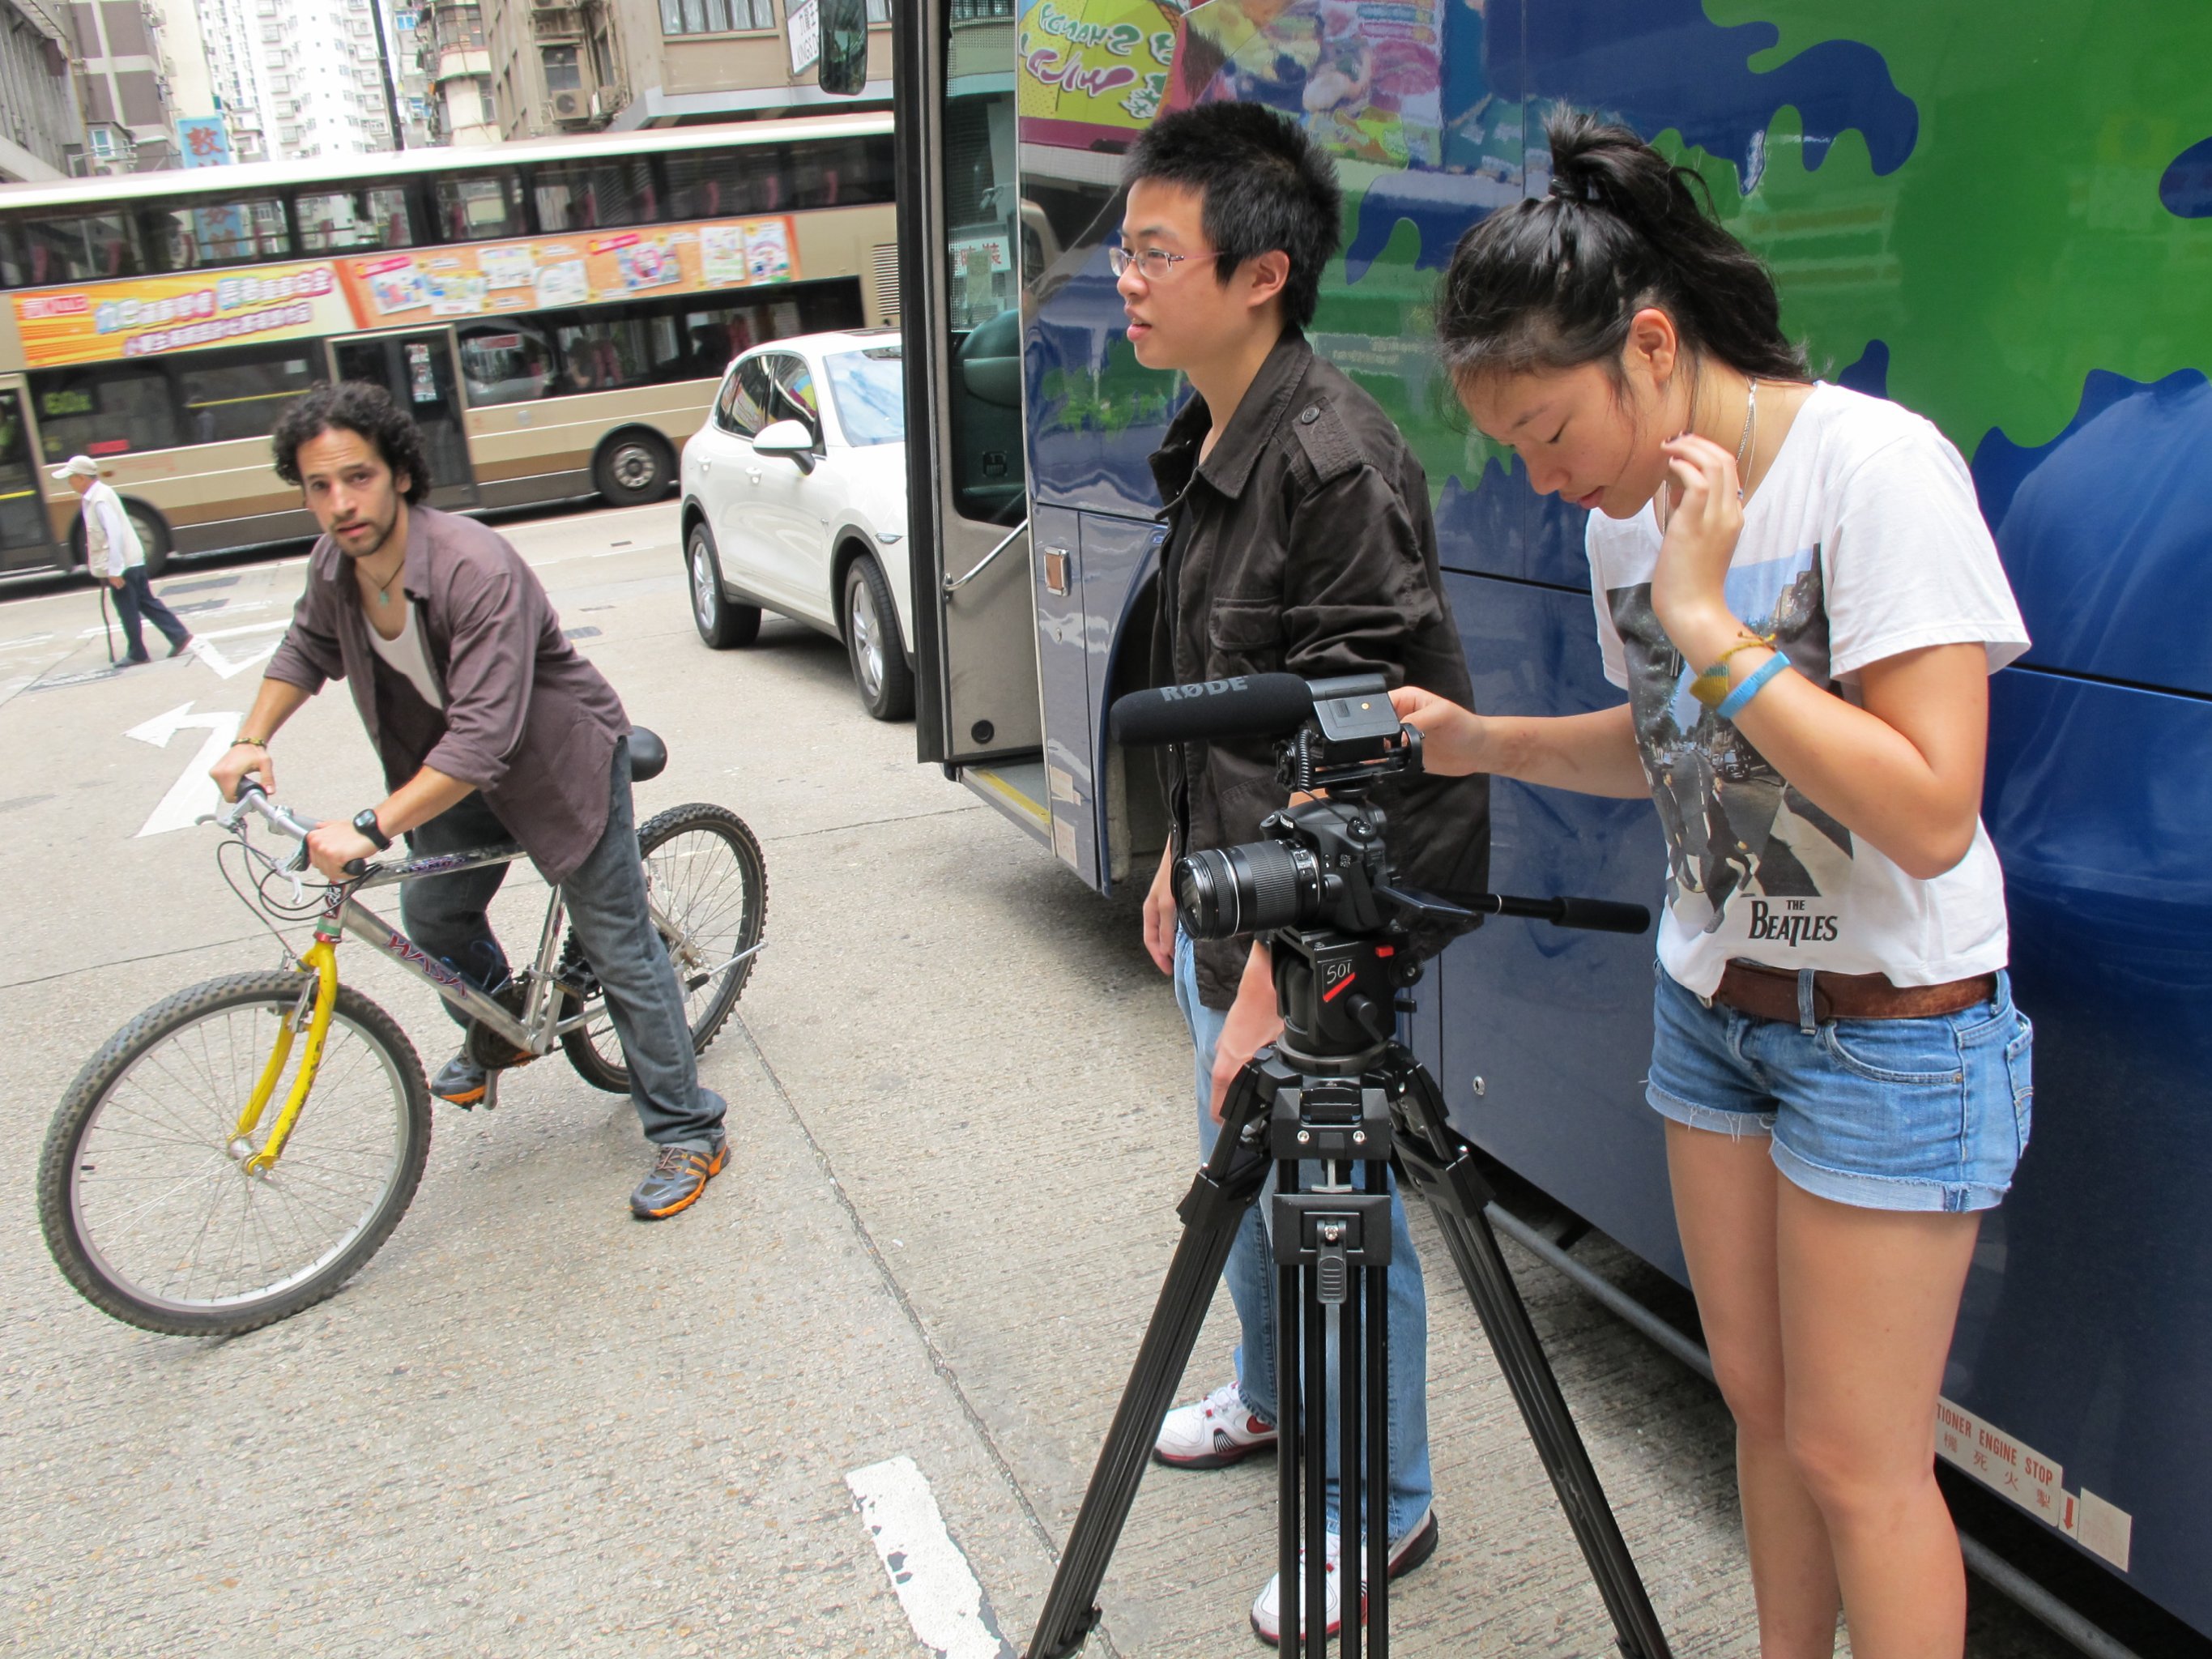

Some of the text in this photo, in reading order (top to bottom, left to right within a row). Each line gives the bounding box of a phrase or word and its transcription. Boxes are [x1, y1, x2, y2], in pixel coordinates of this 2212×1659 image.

[1160, 676, 1248, 702] RØDE
[1786, 899, 1805, 911] THE
[1327, 962, 1351, 985] 501
[1979, 1428, 2017, 1466] ENGINE
[2025, 1456, 2053, 1486] STOP
